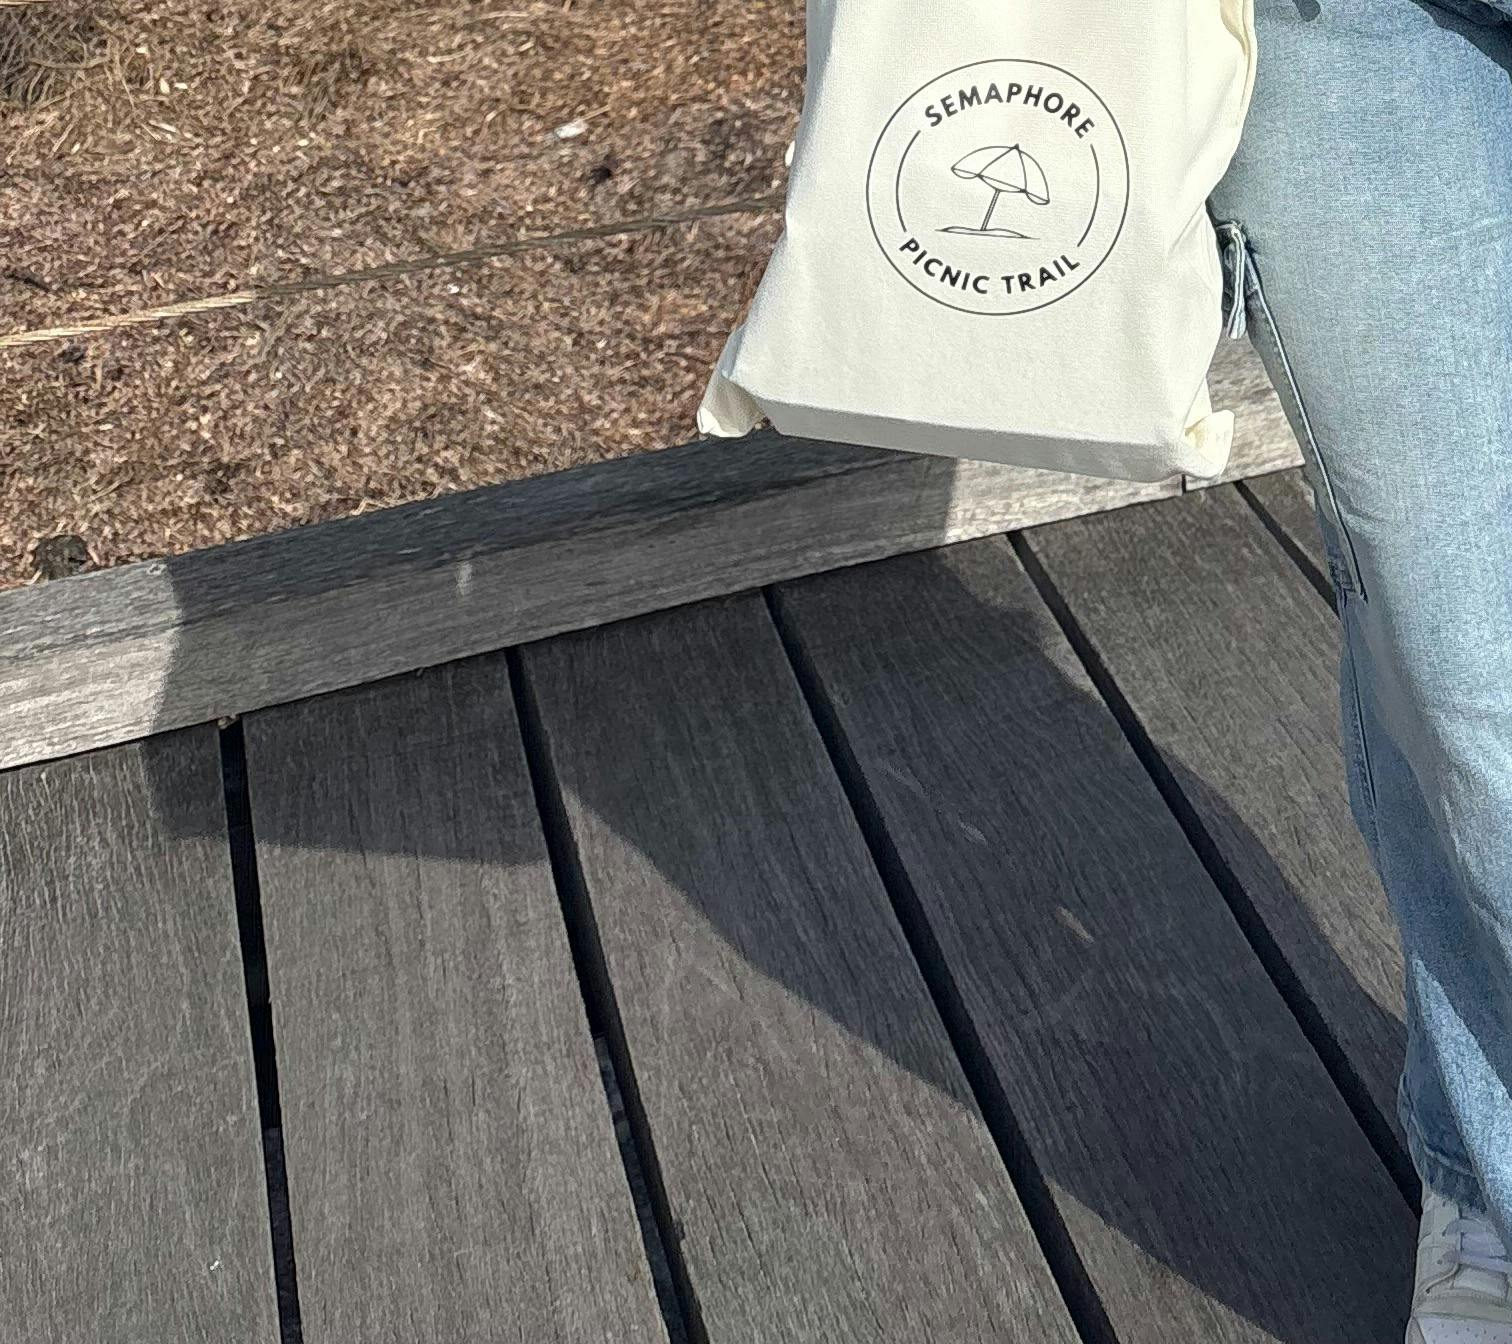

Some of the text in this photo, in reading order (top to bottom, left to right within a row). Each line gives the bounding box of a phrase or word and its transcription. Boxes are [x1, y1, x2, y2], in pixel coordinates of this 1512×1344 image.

[925, 83, 1095, 139] SEMAPHORE
[899, 237, 1081, 294] PICNIC TRAIL
